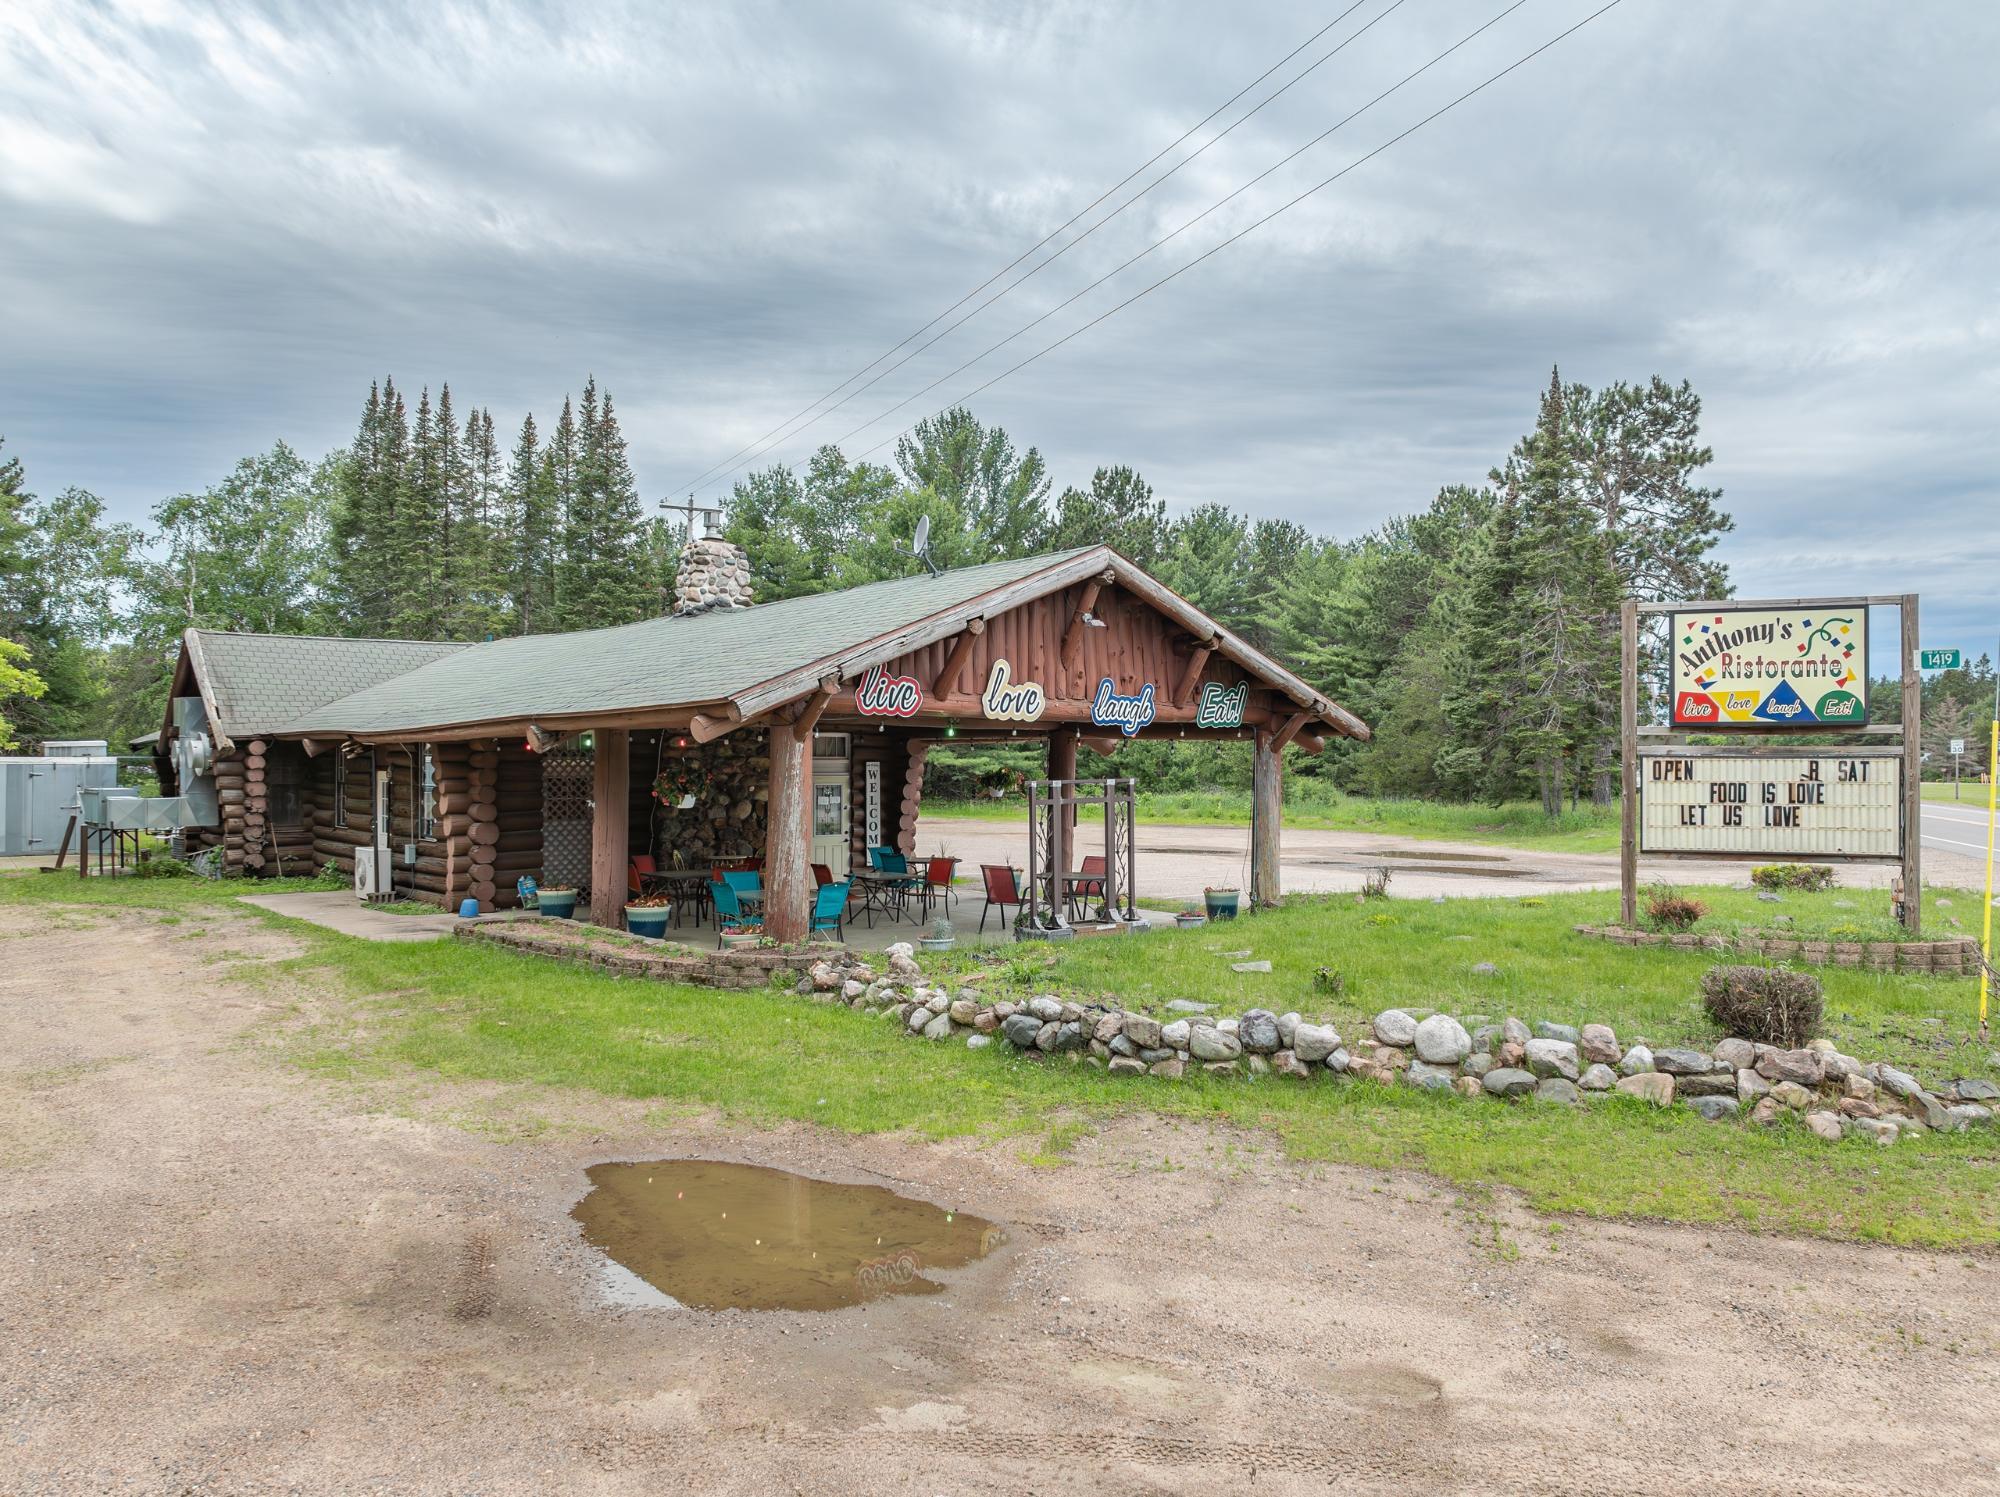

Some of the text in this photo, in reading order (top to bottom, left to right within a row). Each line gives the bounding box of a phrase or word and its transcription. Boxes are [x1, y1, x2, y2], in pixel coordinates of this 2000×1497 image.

[1679, 617, 1793, 677] Anthony's
[1928, 653, 1953, 666] 1419
[1721, 652, 1842, 679] Ristorante
[861, 664, 1246, 729] live love laugh Eat!
[1683, 693, 1856, 718] live love laugh Eat!
[1652, 760, 1694, 781] OPEN
[1838, 760, 1870, 782] SAT
[1710, 782, 1825, 805] FOOD IS LOVE
[867, 769, 879, 845] WELCOM
[1680, 805, 1801, 827] LET US LOVE
